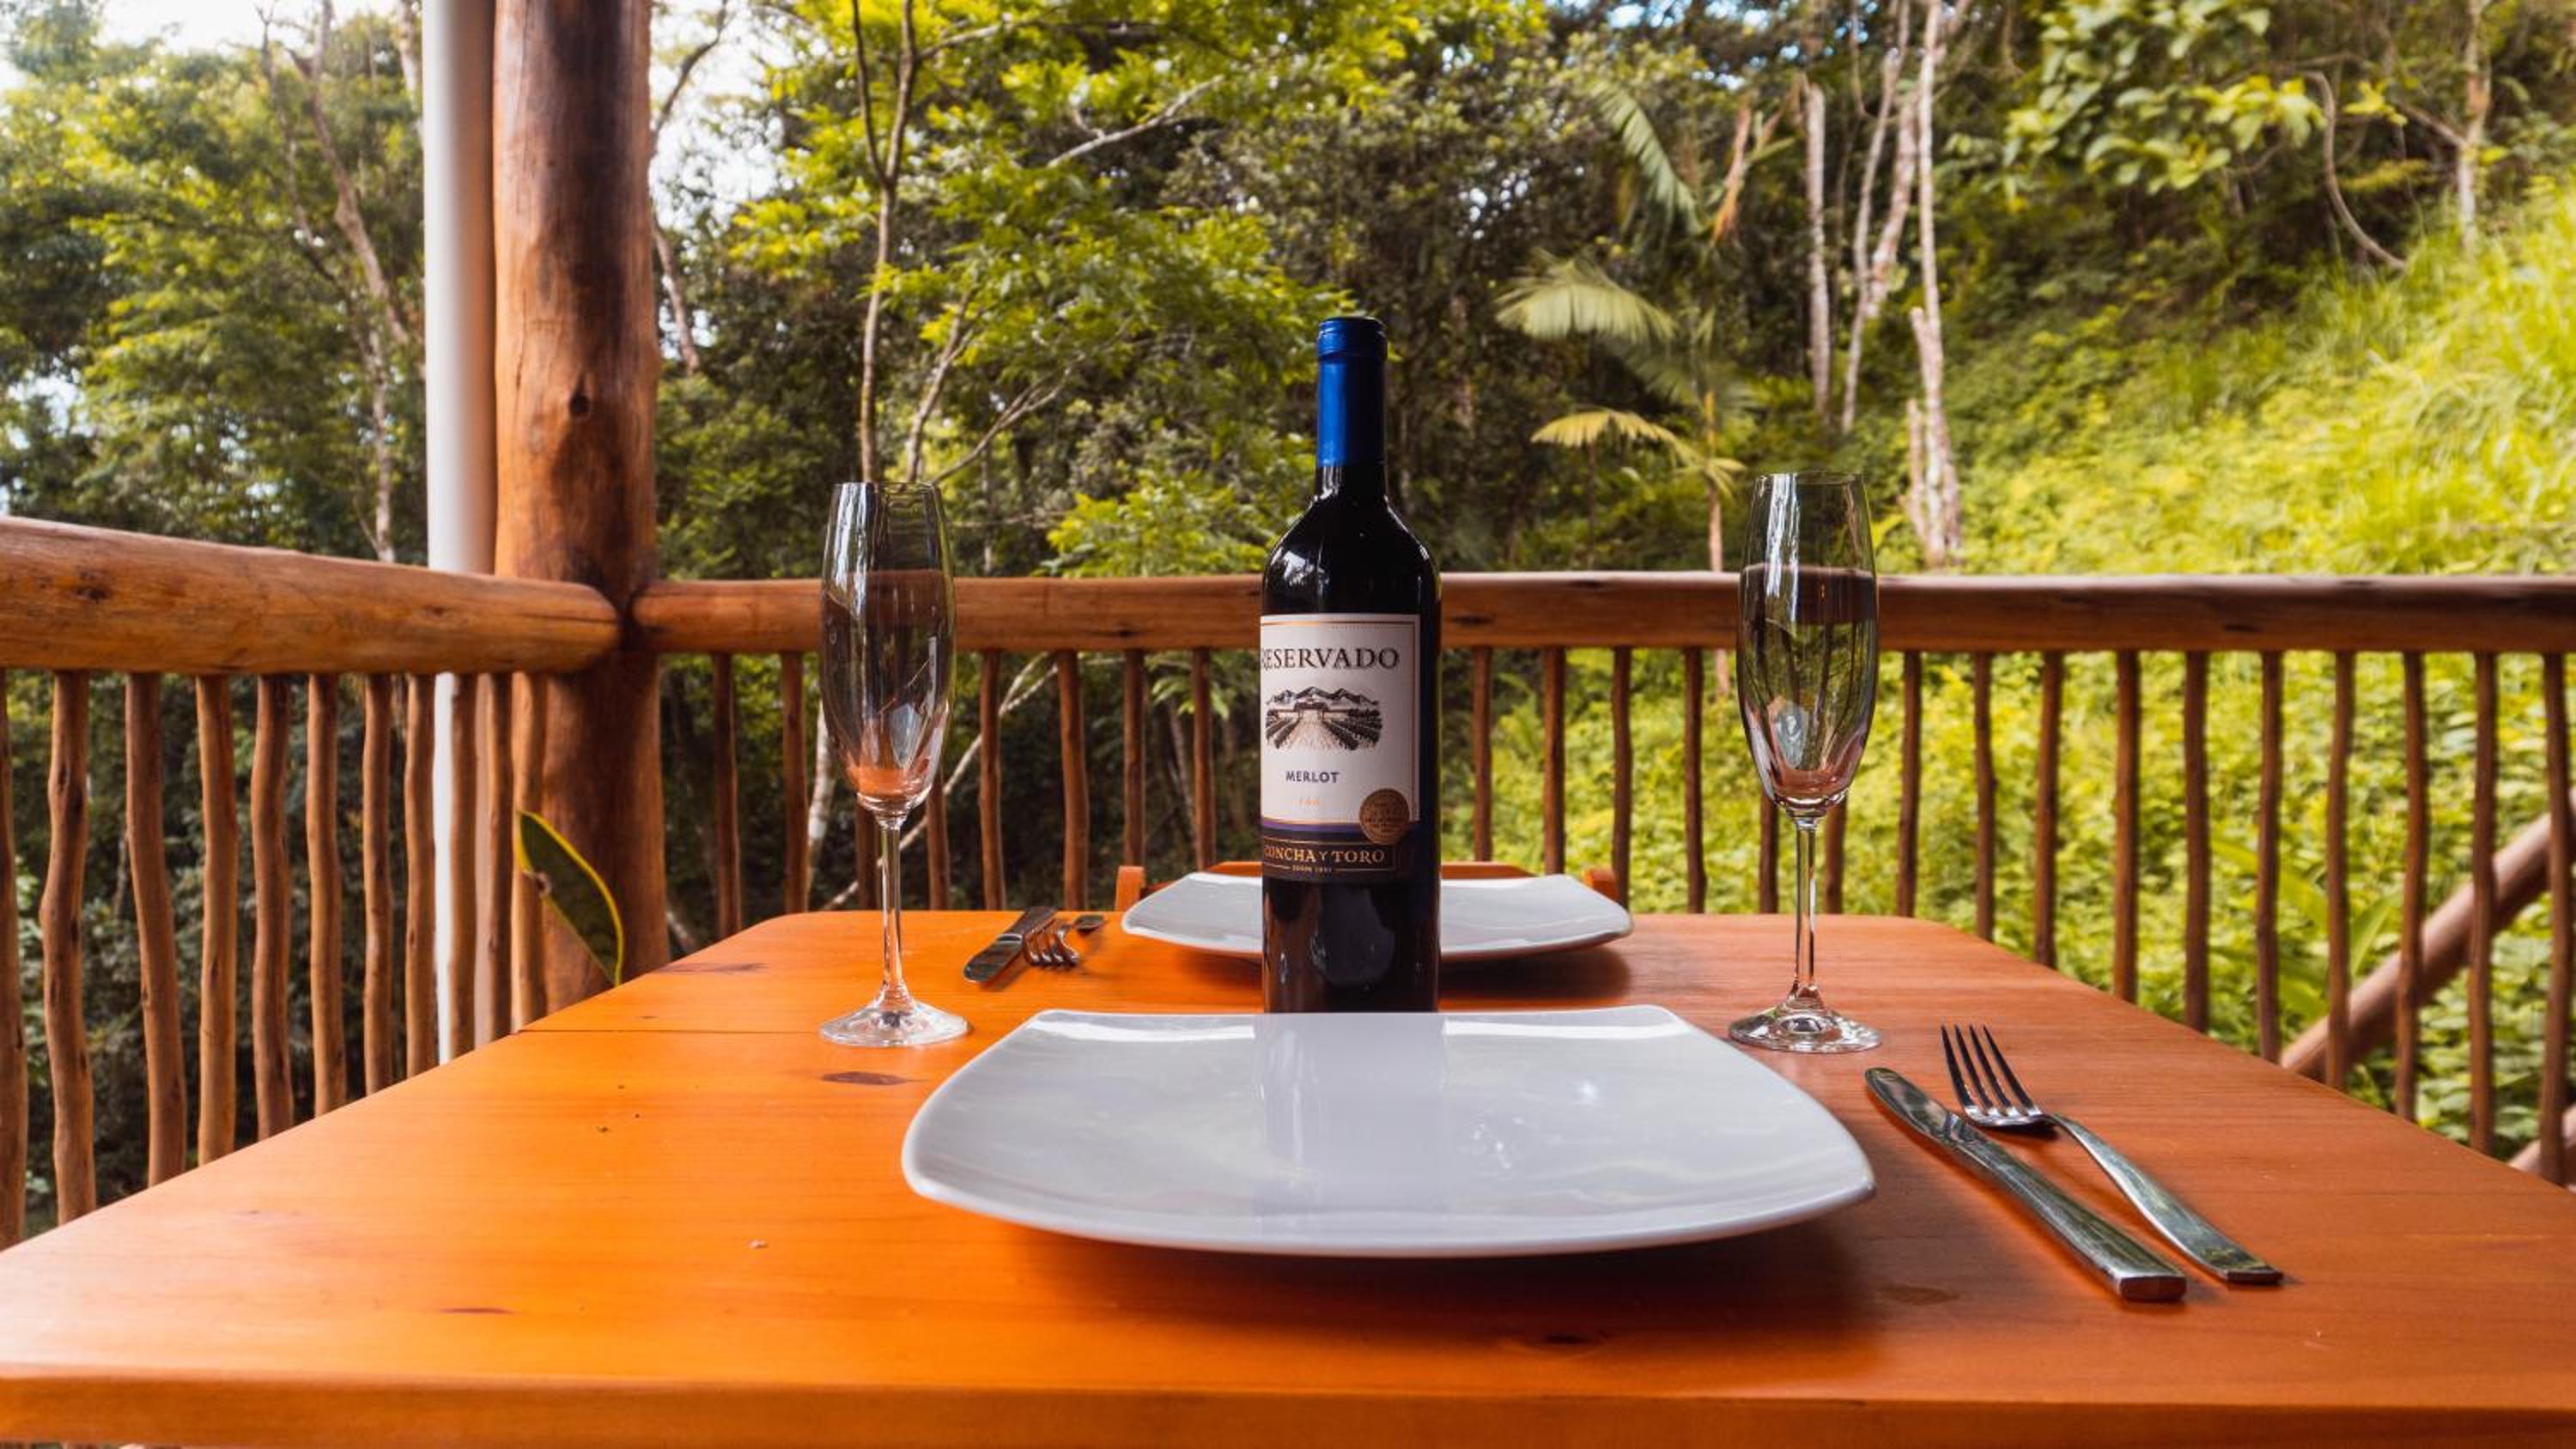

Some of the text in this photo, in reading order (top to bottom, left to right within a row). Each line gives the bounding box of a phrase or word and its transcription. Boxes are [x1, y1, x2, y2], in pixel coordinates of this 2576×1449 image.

[1285, 770, 1340, 783] MERLOT
[1319, 851, 1327, 862] Y
[1331, 851, 1384, 864] TORO
